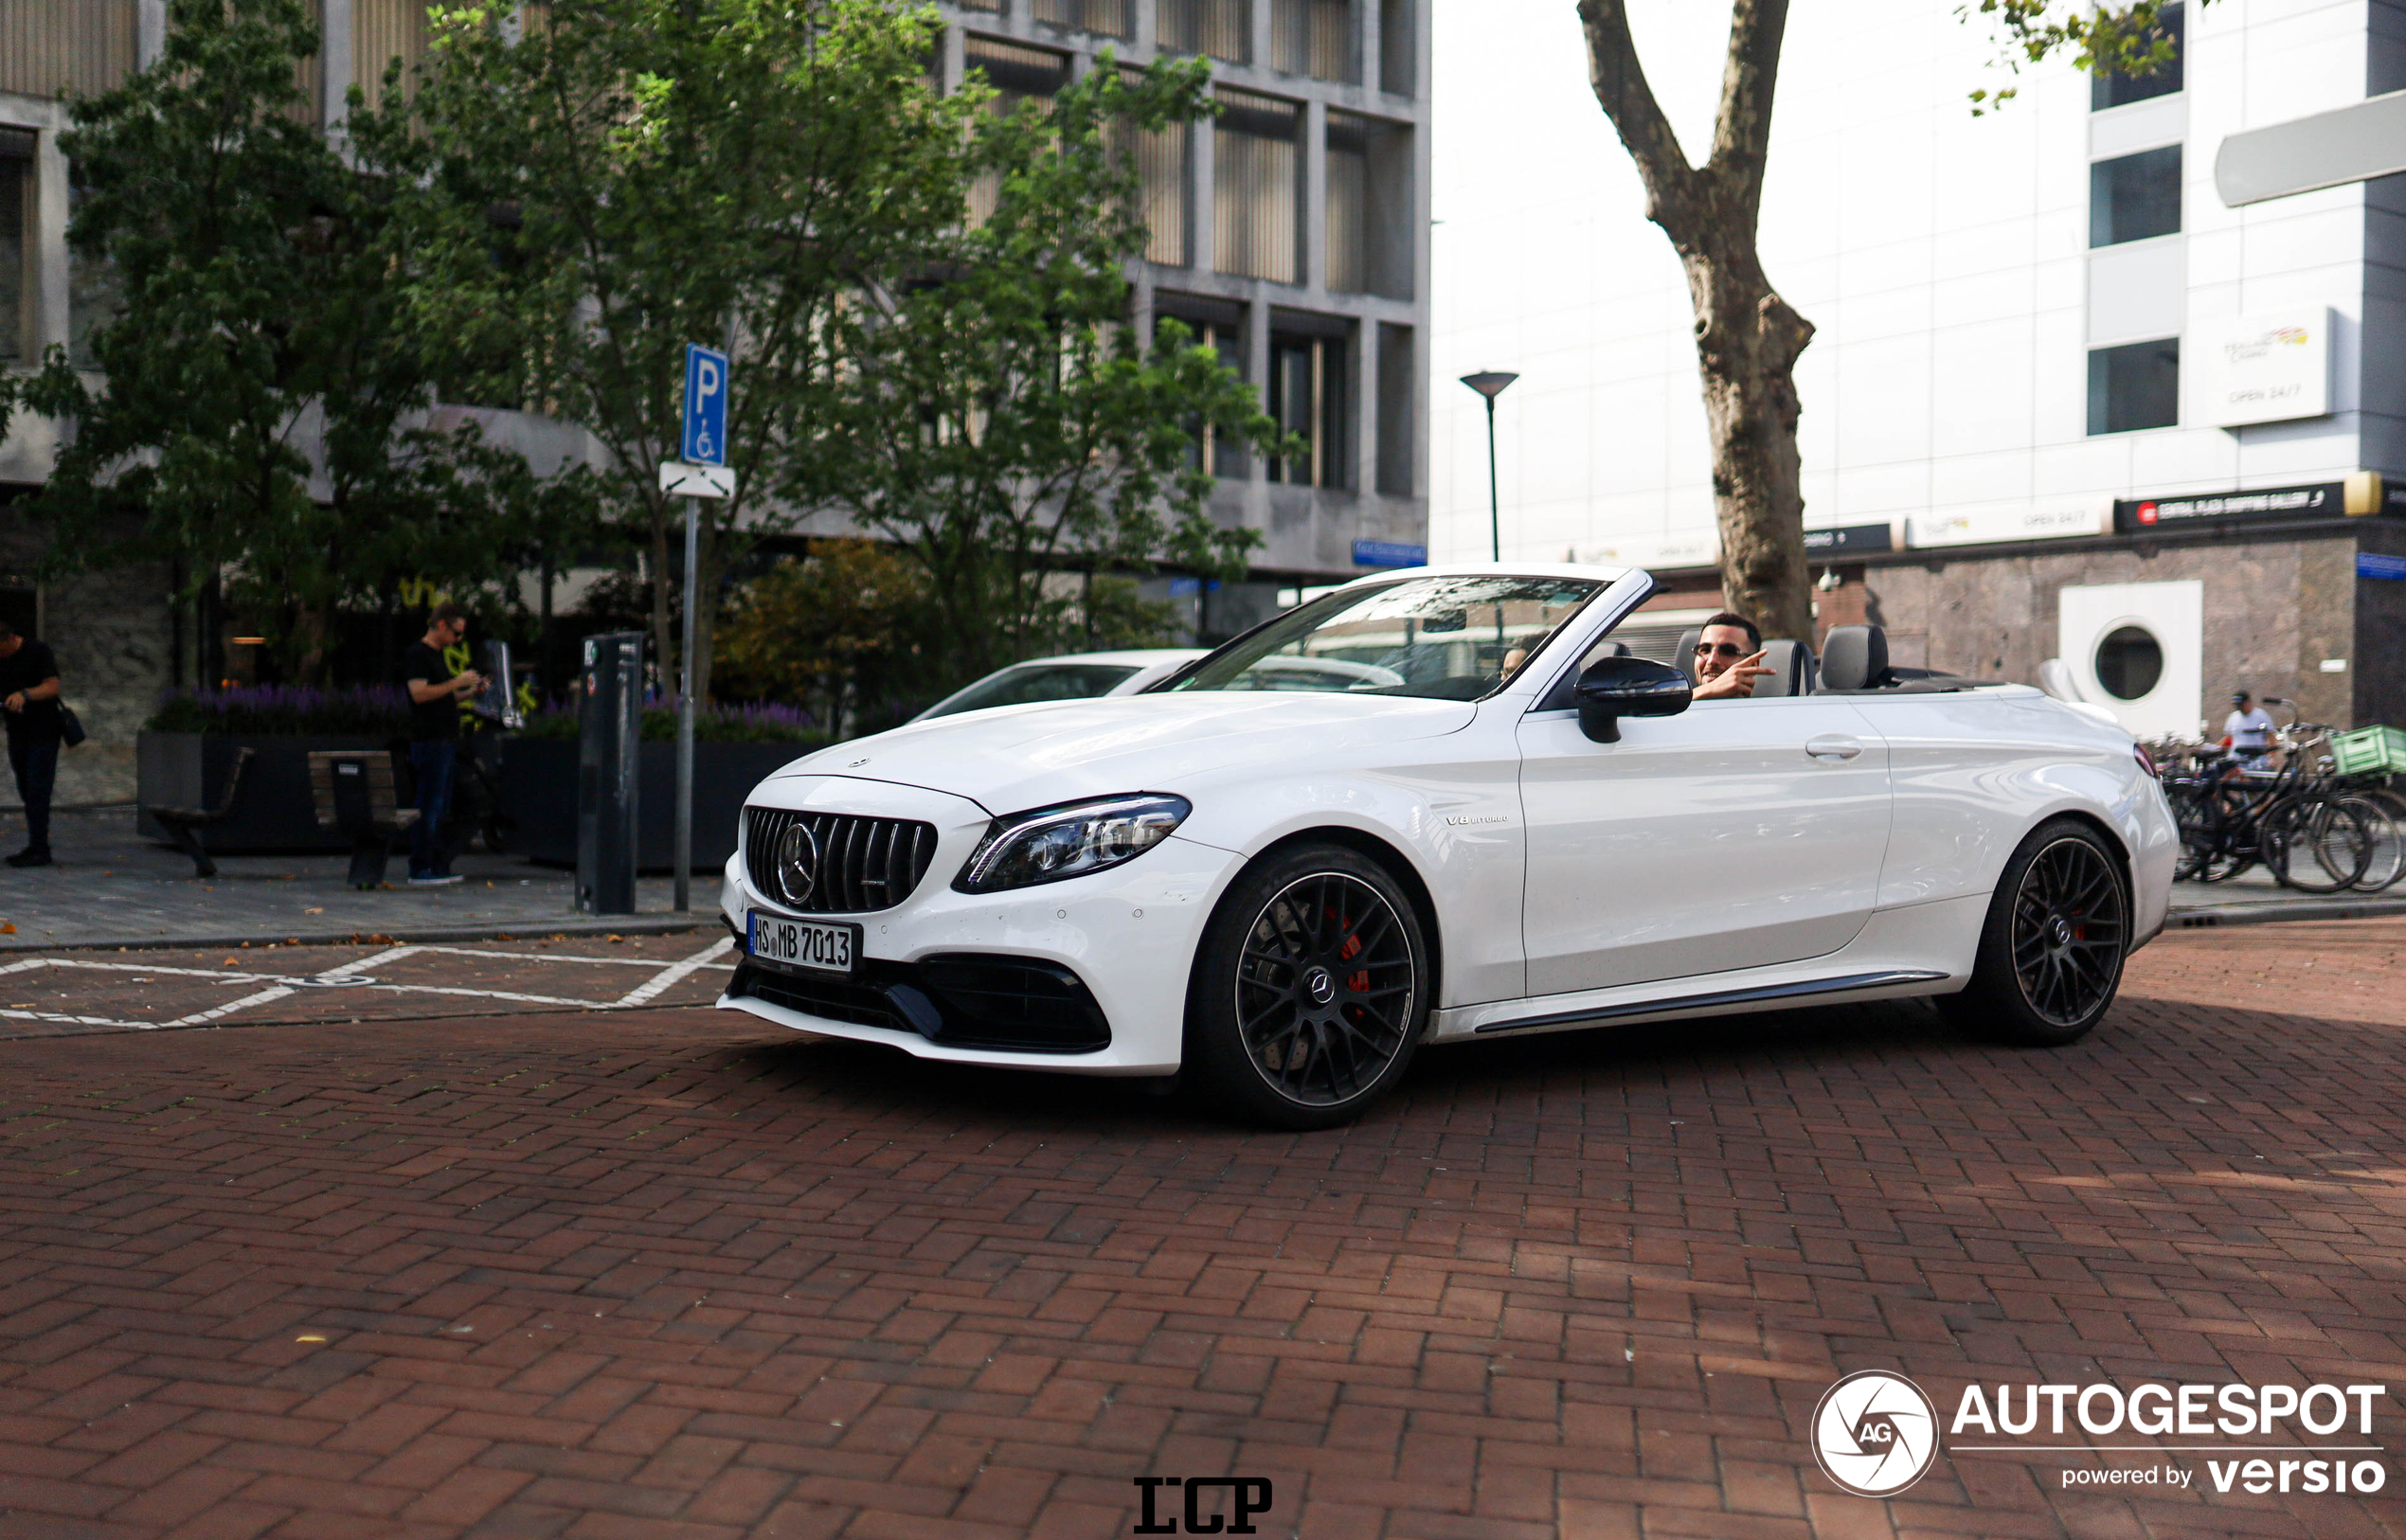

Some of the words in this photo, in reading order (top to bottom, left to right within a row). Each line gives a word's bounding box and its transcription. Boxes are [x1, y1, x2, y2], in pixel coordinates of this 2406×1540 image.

[696, 358, 719, 414] P
[2228, 389, 2265, 403] OPEN
[2269, 383, 2302, 399] 24/7
[2023, 512, 2056, 528] OPEN
[2058, 510, 2086, 525] 24/7
[2158, 501, 2195, 520] CENTRAL
[1446, 815, 1469, 825] V8
[1471, 815, 1509, 824] BITURBO
[755, 918, 769, 953] HS
[778, 922, 798, 958] MB
[801, 926, 850, 966] 7013
